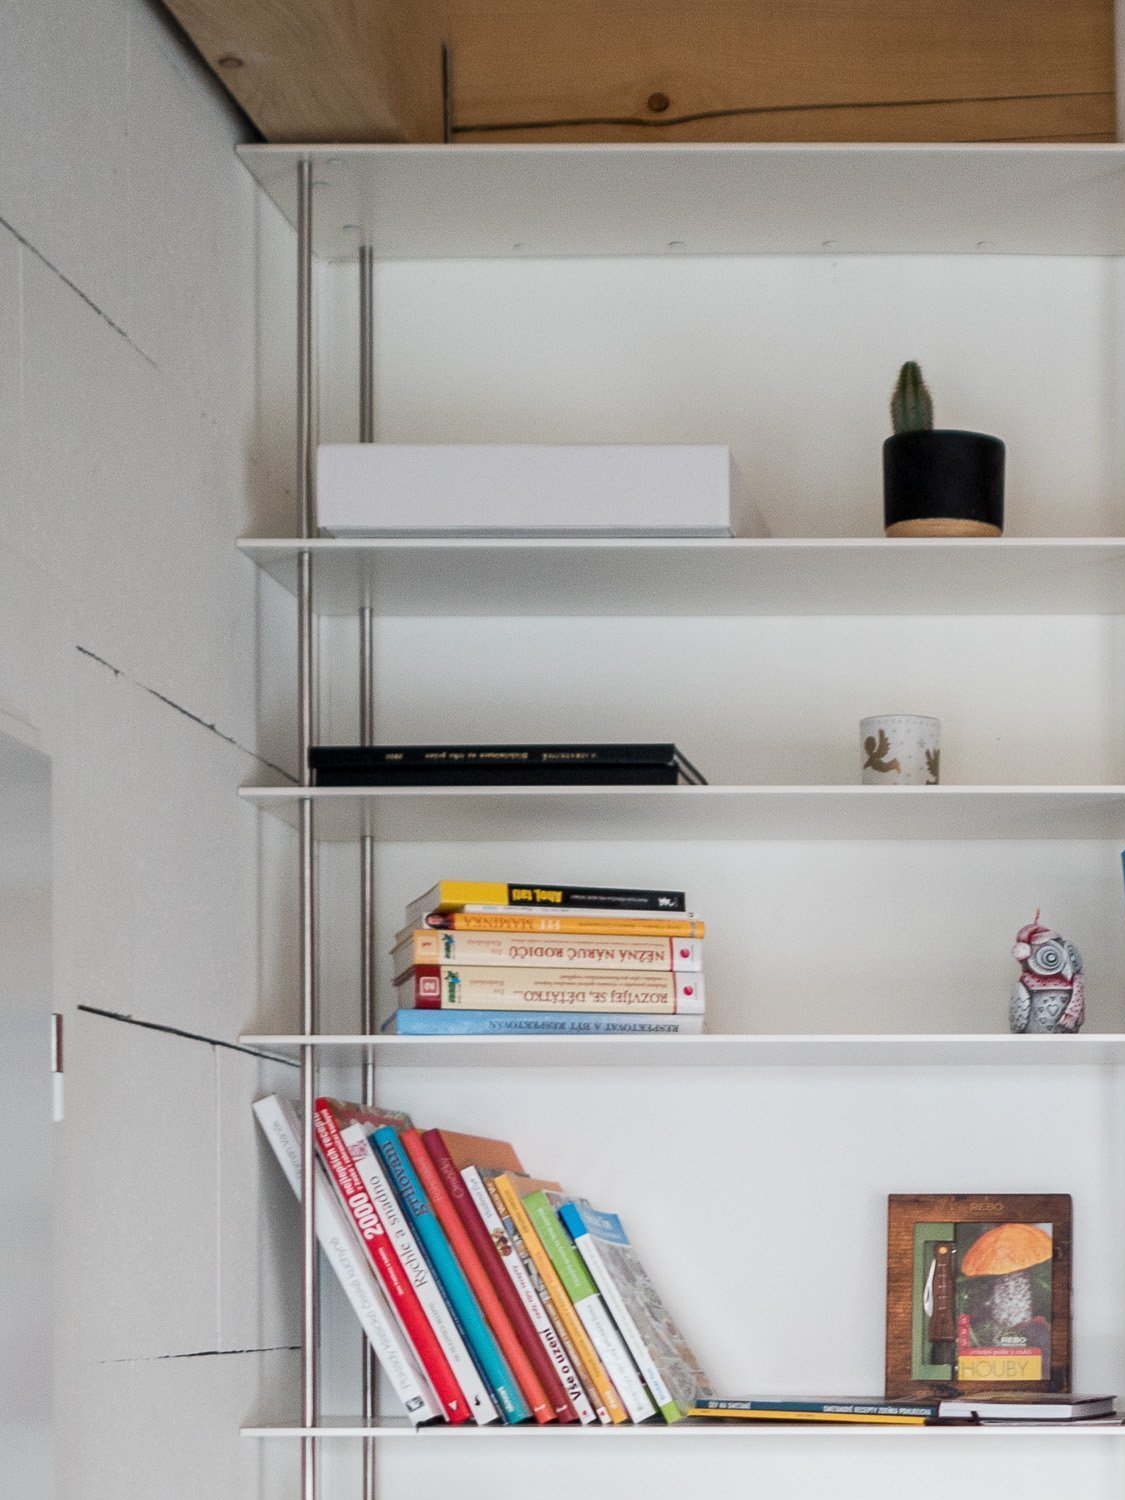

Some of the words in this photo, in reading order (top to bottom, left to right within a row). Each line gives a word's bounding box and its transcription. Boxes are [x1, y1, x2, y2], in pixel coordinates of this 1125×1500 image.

[509, 944, 564, 961] RODIČŮ
[566, 945, 614, 962] NÁRUČ
[616, 946, 665, 963] NĚŽNÁ
[588, 990, 607, 1004] SE,
[611, 989, 669, 1004] ROZVÍJEJ
[593, 1022, 601, 1033] A
[606, 1022, 679, 1034] RESPEKTOVAT
[379, 1136, 428, 1220] grilování
[436, 1153, 466, 1200] Omáčky
[366, 1172, 400, 1228] snadno
[348, 1189, 384, 1240] 2000
[393, 1227, 406, 1239] a
[397, 1239, 430, 1289] Rychle
[538, 1326, 566, 1365] uzení
[1000, 1336, 1027, 1344] REBO
[558, 1362, 571, 1375] o
[961, 1360, 1030, 1378] HOUBY
[561, 1374, 583, 1402] Vše
